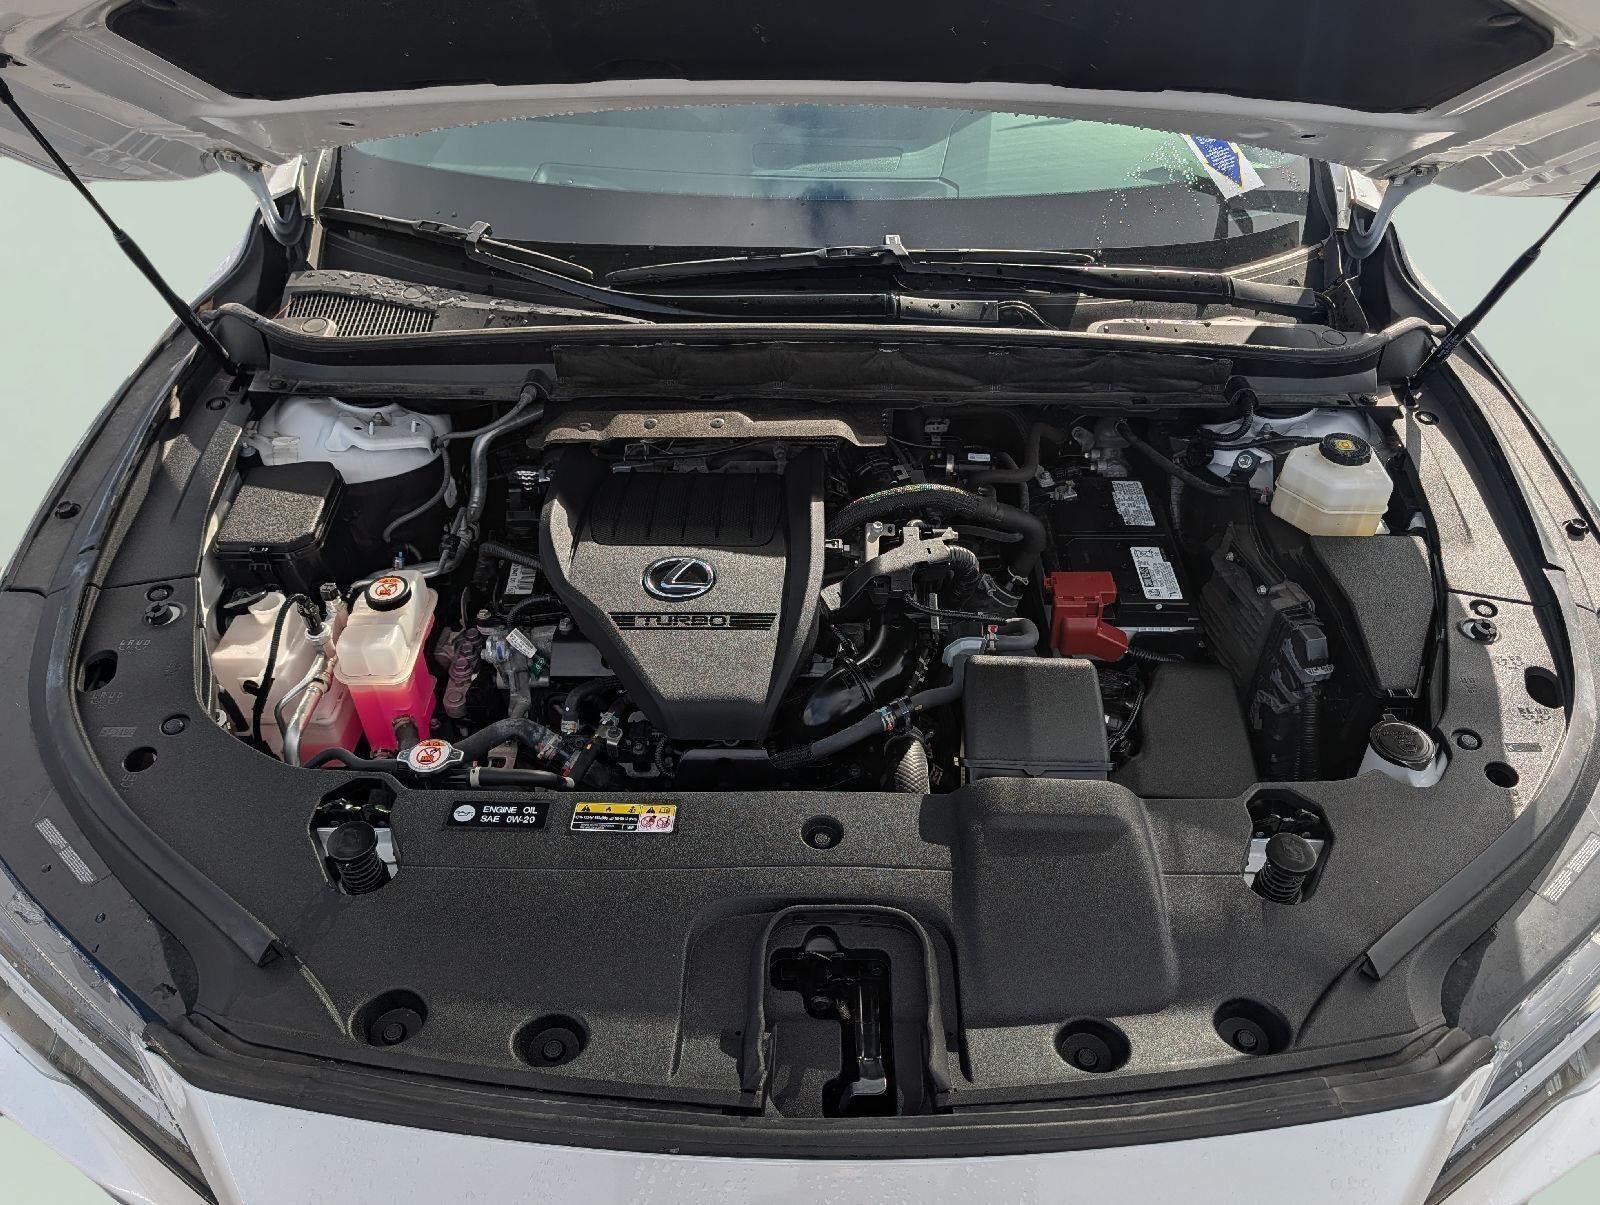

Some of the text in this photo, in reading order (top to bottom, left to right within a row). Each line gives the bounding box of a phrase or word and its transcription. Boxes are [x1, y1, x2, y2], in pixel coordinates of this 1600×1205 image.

[638, 615, 727, 627] TURBO
[482, 805, 538, 814] ENGINE OIL
[480, 815, 536, 824] SAE 0W-20
